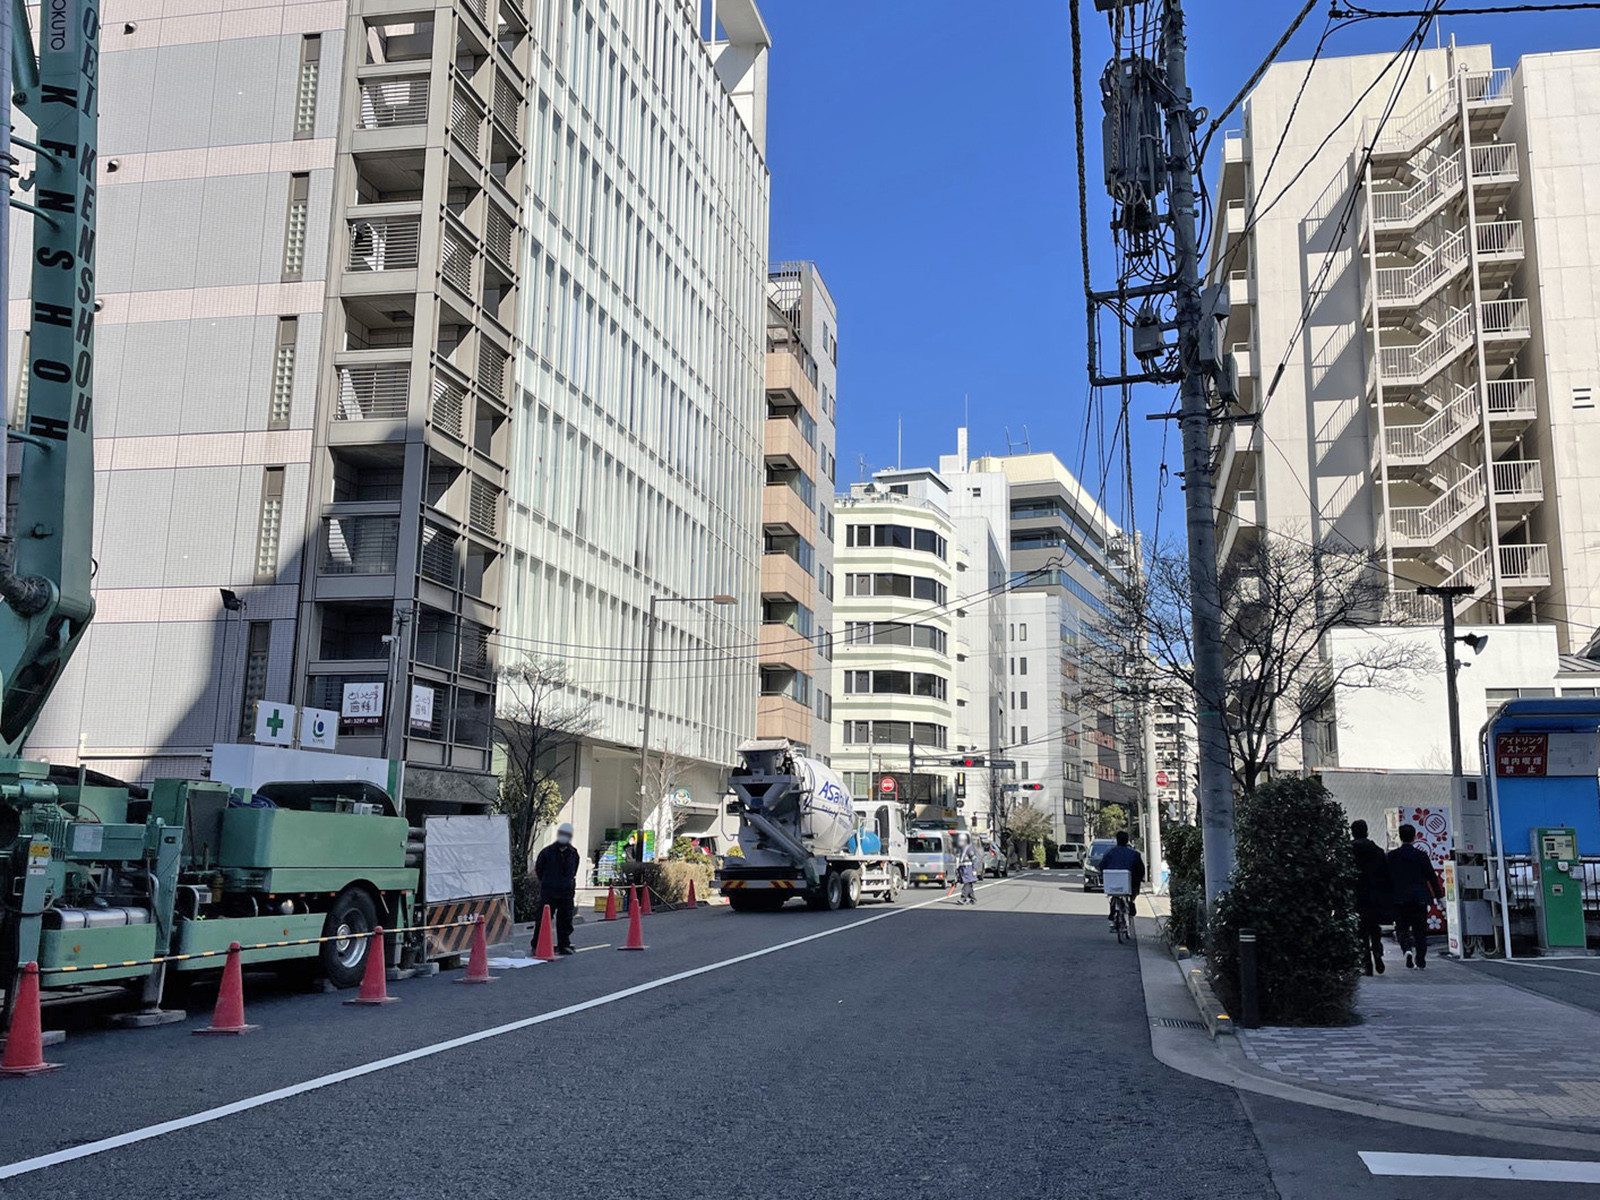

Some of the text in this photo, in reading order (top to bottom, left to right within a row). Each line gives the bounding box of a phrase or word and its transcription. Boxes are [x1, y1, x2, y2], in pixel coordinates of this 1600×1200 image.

[30, 84, 78, 441] KENSHOH
[73, 142, 96, 433] KENSHOH
[1500, 736, 1544, 745] アイドリング
[1507, 745, 1537, 753] ストップ
